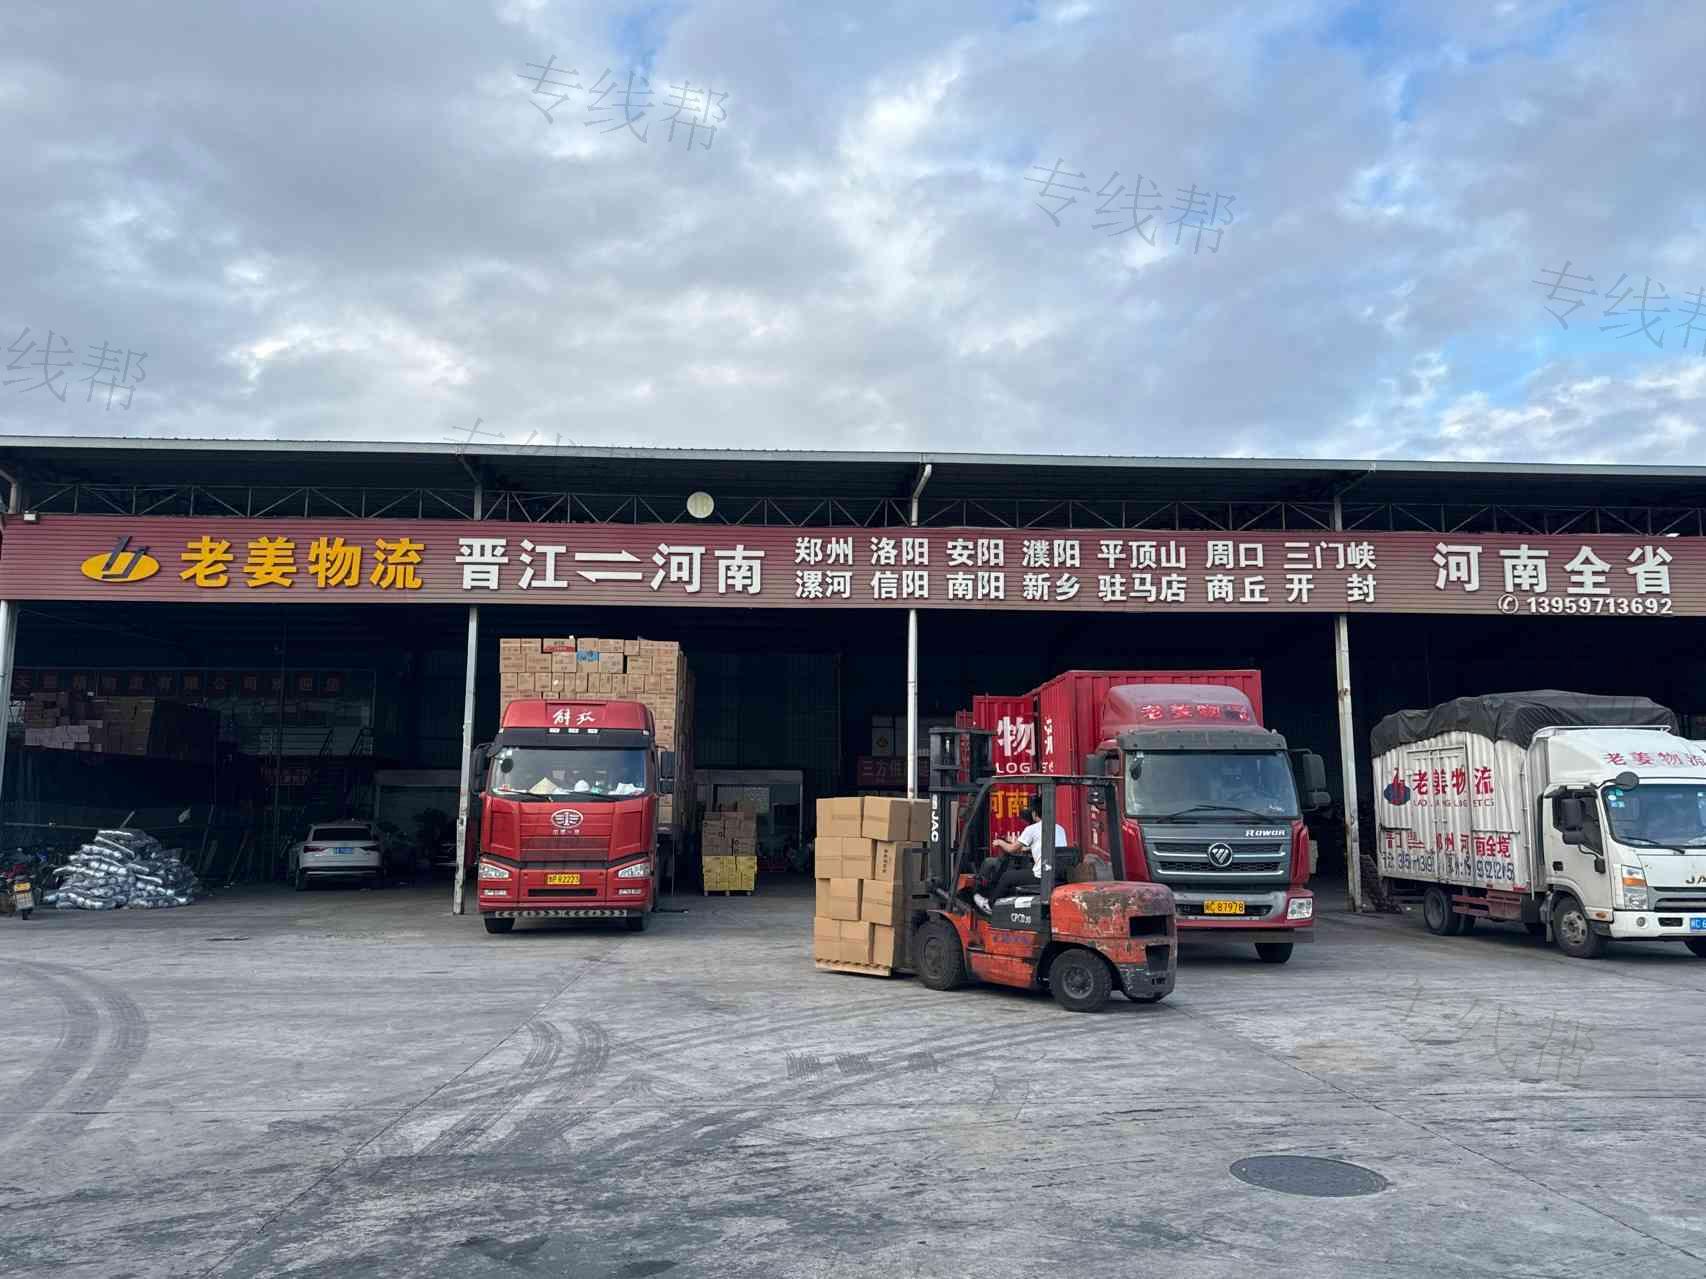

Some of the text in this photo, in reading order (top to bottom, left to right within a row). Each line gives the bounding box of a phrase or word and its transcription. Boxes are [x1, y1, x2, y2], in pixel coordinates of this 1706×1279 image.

[179, 535, 425, 589] 老姜物流
[455, 537, 765, 594] 晋江 河南
[795, 537, 1377, 570] 郑州 洛阳 安阳 濮阳 平顶山 周口 三门峡
[1433, 542, 1673, 595] 河南全省
[795, 570, 853, 599] 漯河
[870, 571, 929, 599] 信阳
[946, 571, 1004, 600] 南阳
[1023, 573, 1080, 601] 新乡
[1098, 573, 1187, 602] 驻马店
[1205, 574, 1269, 602] 商丘
[1526, 597, 1673, 614] 13959713692
[1412, 766, 1494, 796] 老姜物流
